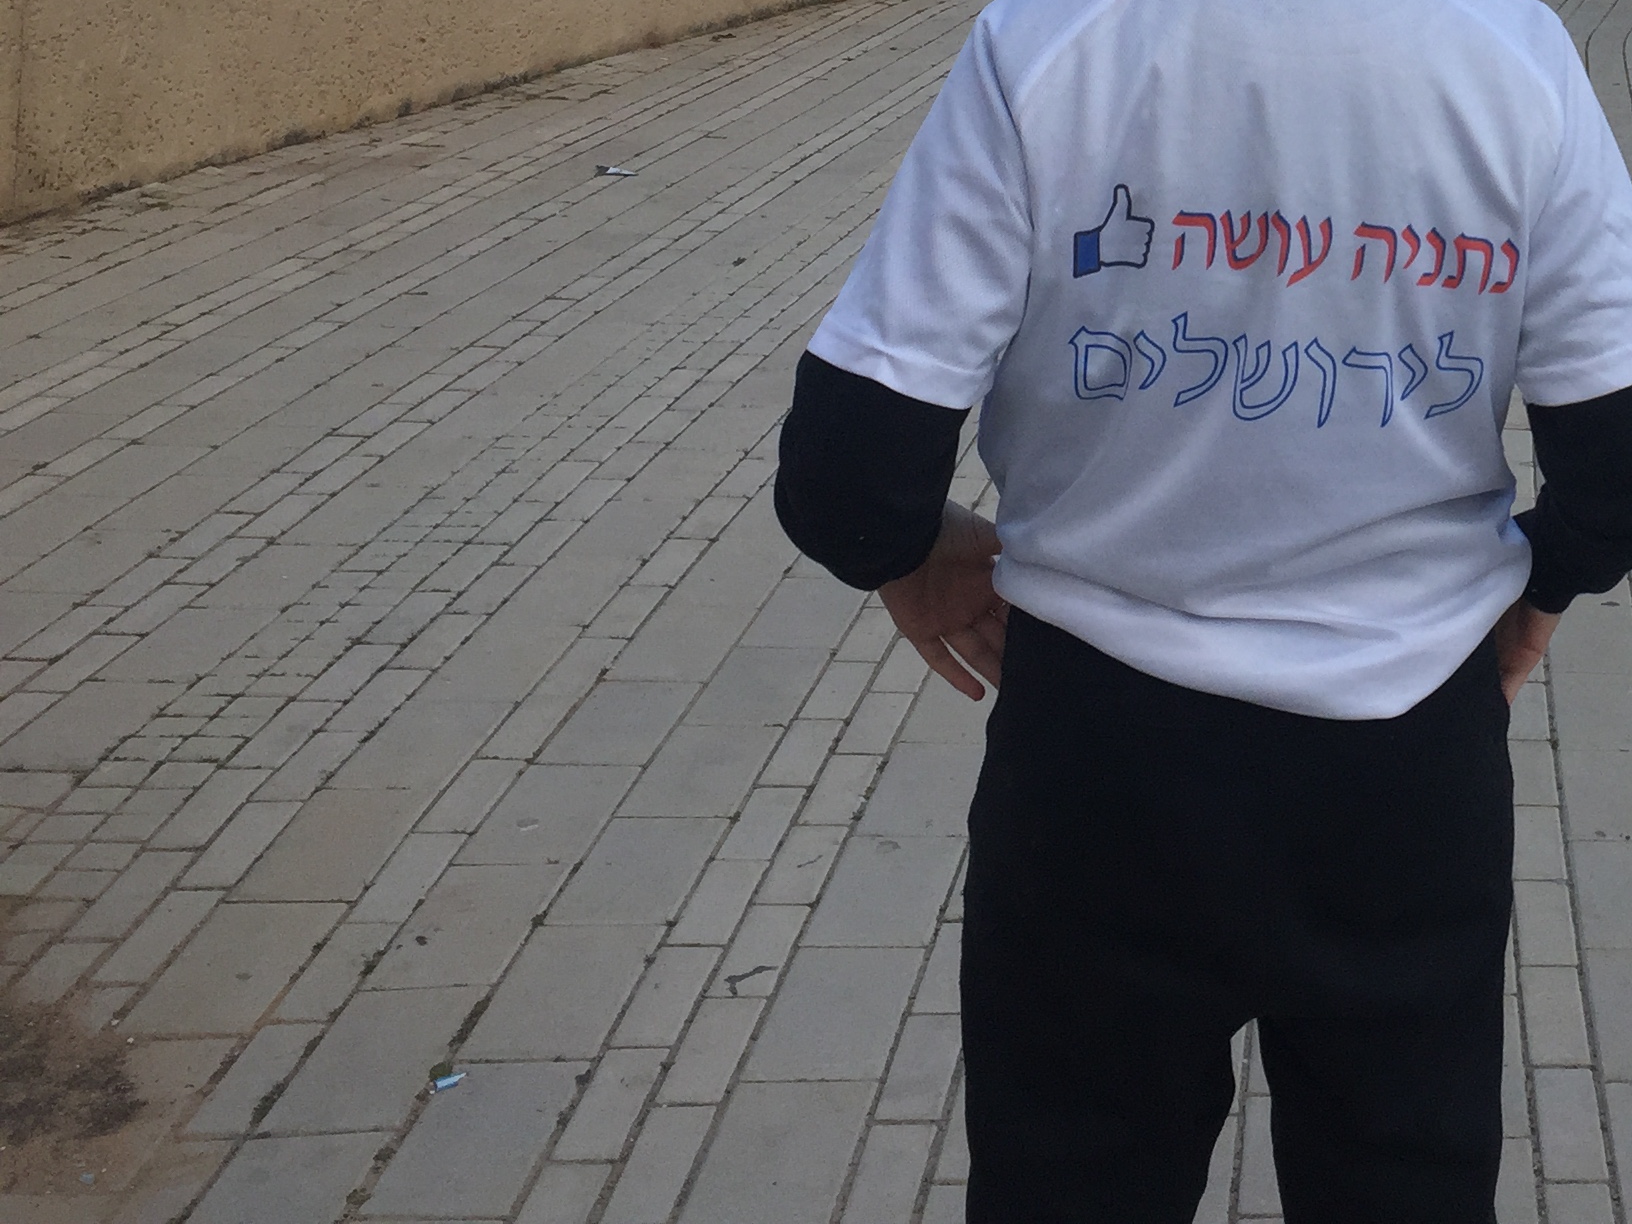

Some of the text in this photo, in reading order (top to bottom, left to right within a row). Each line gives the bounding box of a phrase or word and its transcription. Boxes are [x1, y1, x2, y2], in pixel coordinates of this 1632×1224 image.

[1170, 209, 1520, 295] נתניה עושה
[1068, 311, 1485, 428] לירושלים
